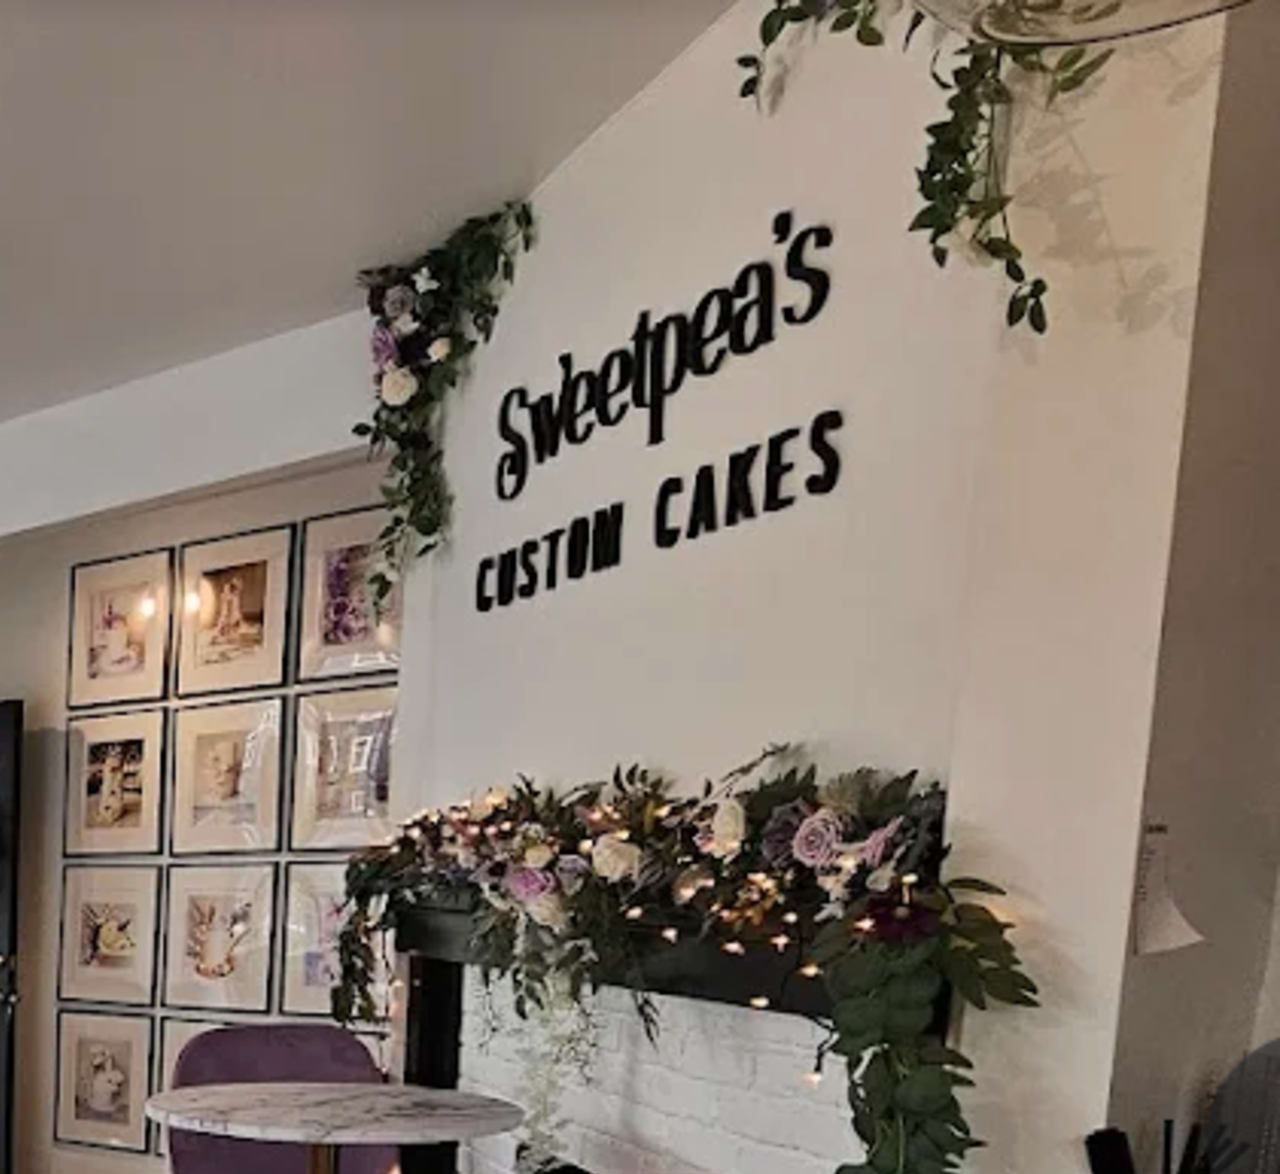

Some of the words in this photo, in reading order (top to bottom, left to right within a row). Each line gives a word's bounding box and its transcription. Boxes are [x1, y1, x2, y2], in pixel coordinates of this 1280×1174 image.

[496, 210, 835, 500] Sweetpea's
[475, 502, 625, 612] CUSTOM
[653, 410, 844, 548] CAKES
